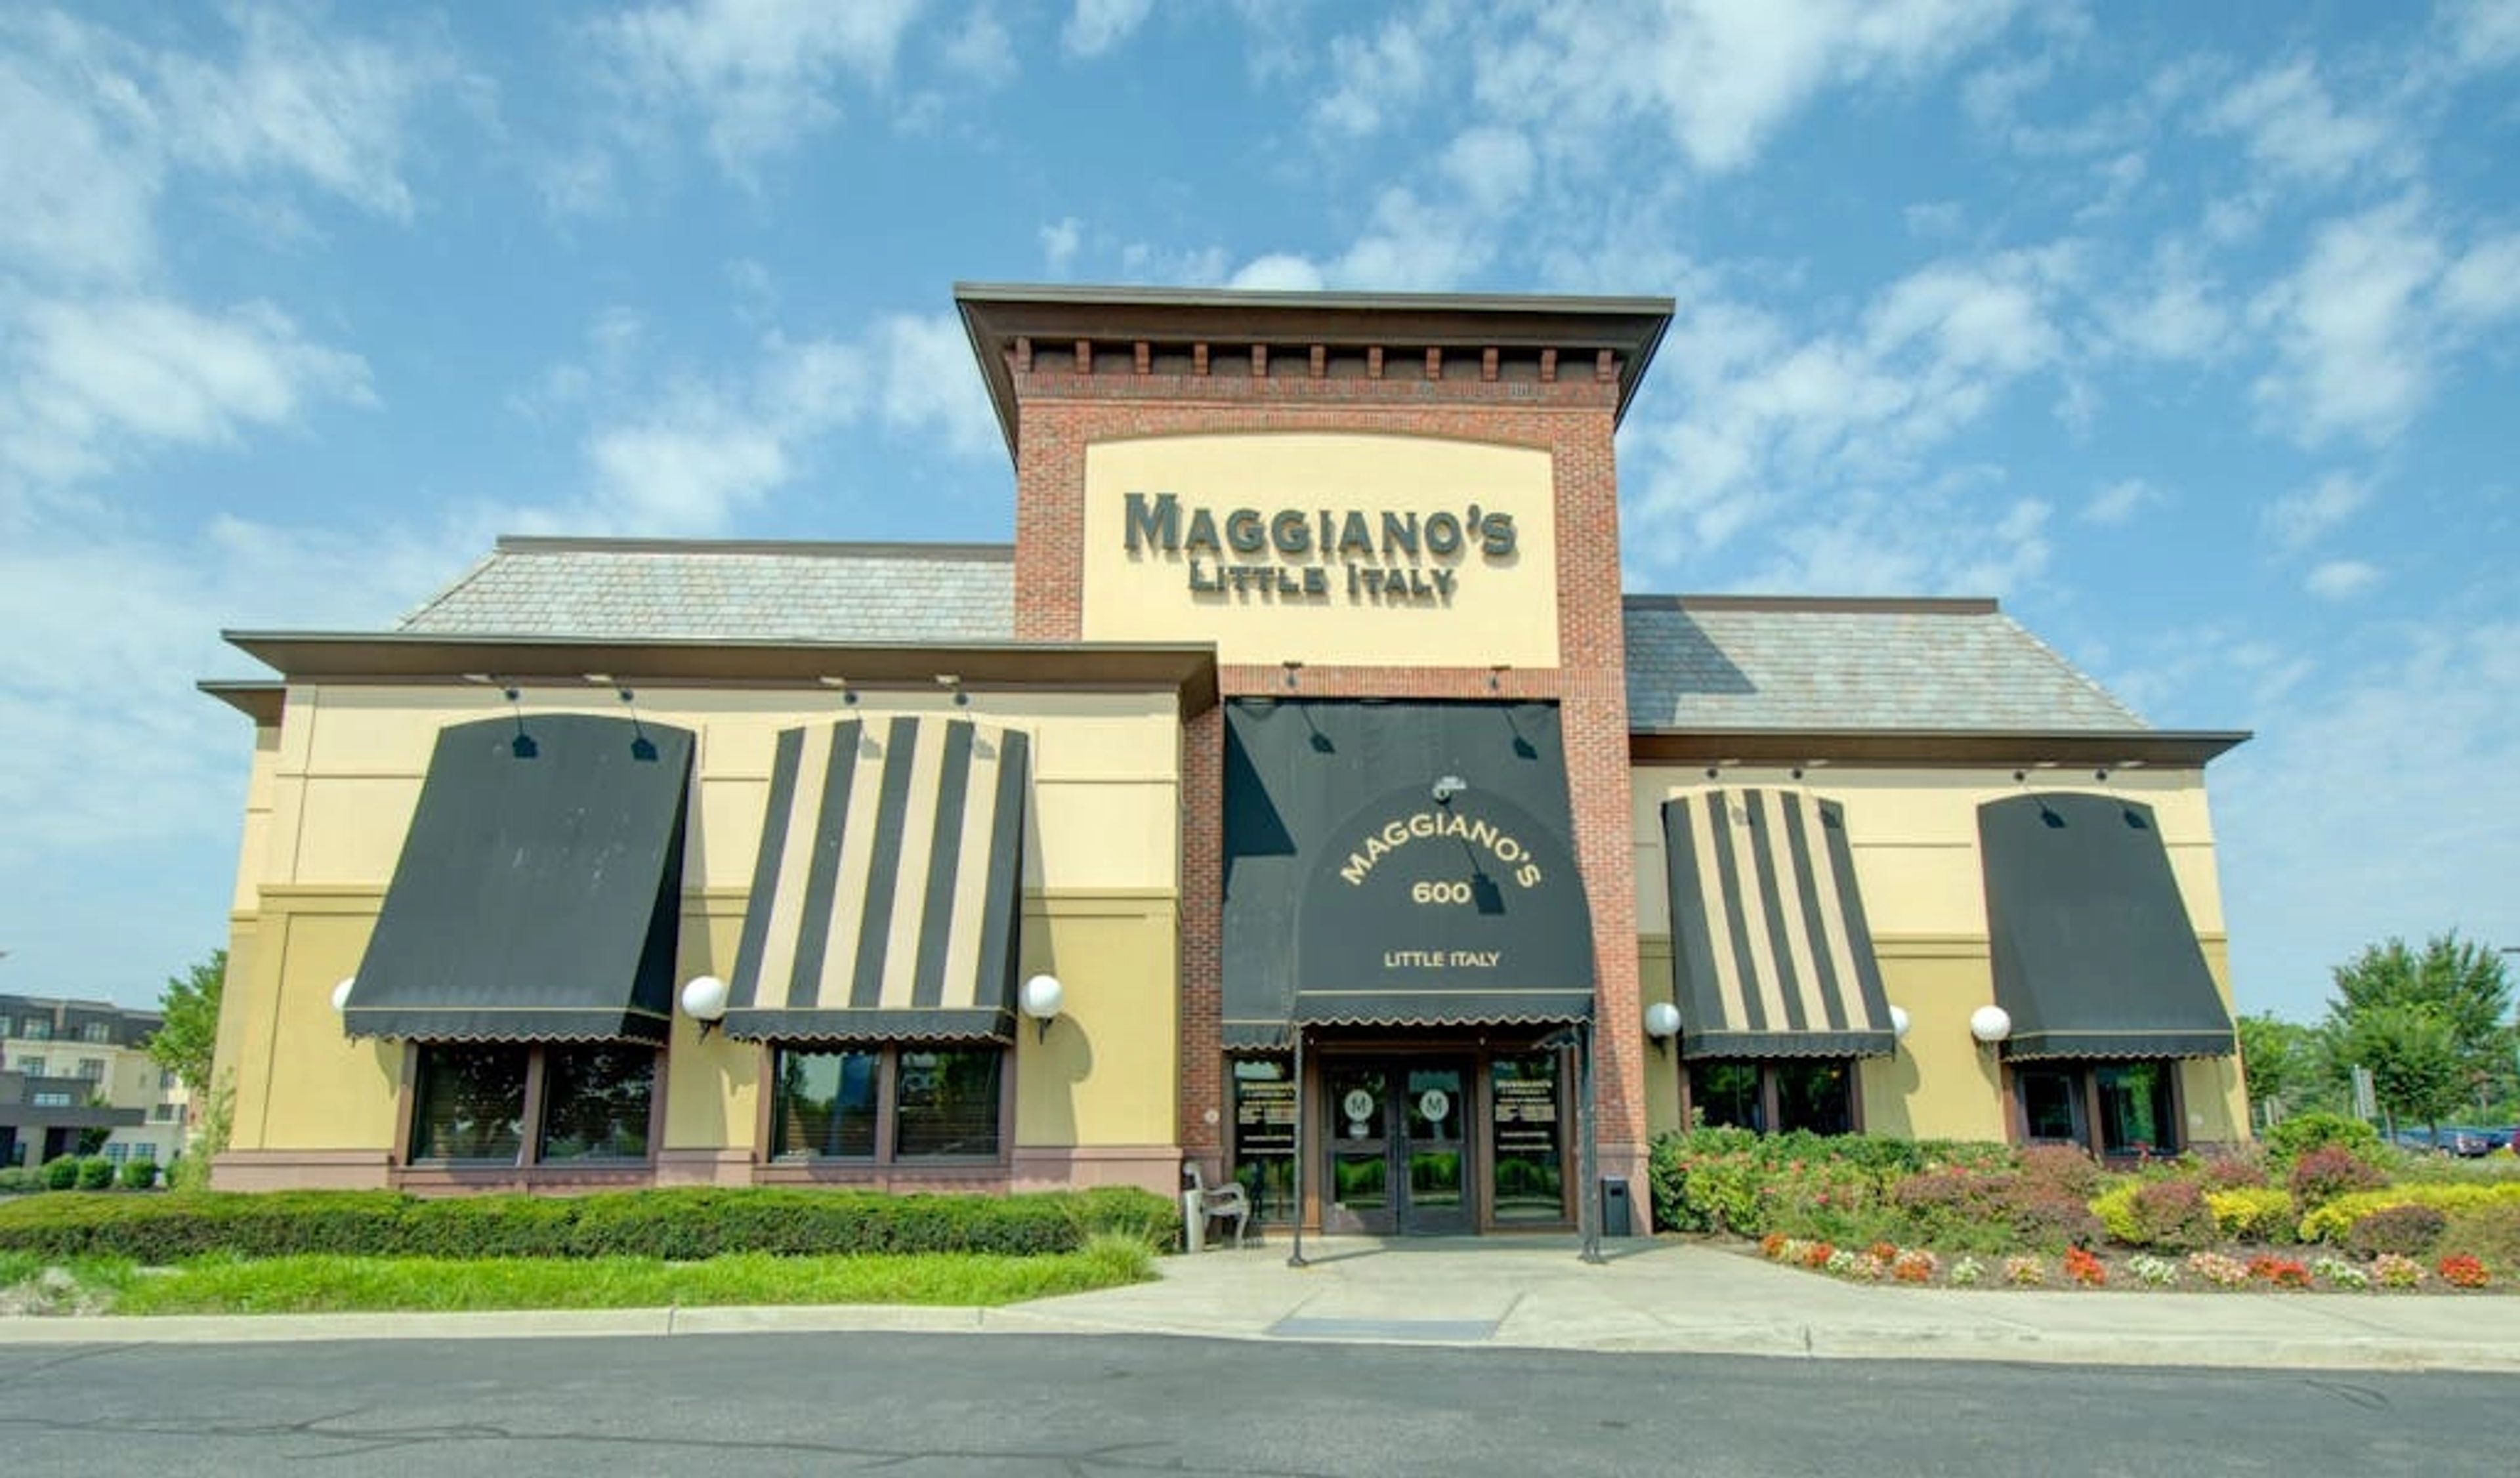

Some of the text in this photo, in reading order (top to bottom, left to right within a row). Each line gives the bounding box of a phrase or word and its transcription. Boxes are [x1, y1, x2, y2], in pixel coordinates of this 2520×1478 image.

[1123, 492, 1516, 560] MAGGIANO'S
[1188, 559, 1454, 601] LITTLE ITALY
[1339, 812, 1542, 888] MAGGIANO'S
[1412, 881, 1471, 904] 600
[1384, 951, 1500, 968] LITTLE ITALY
